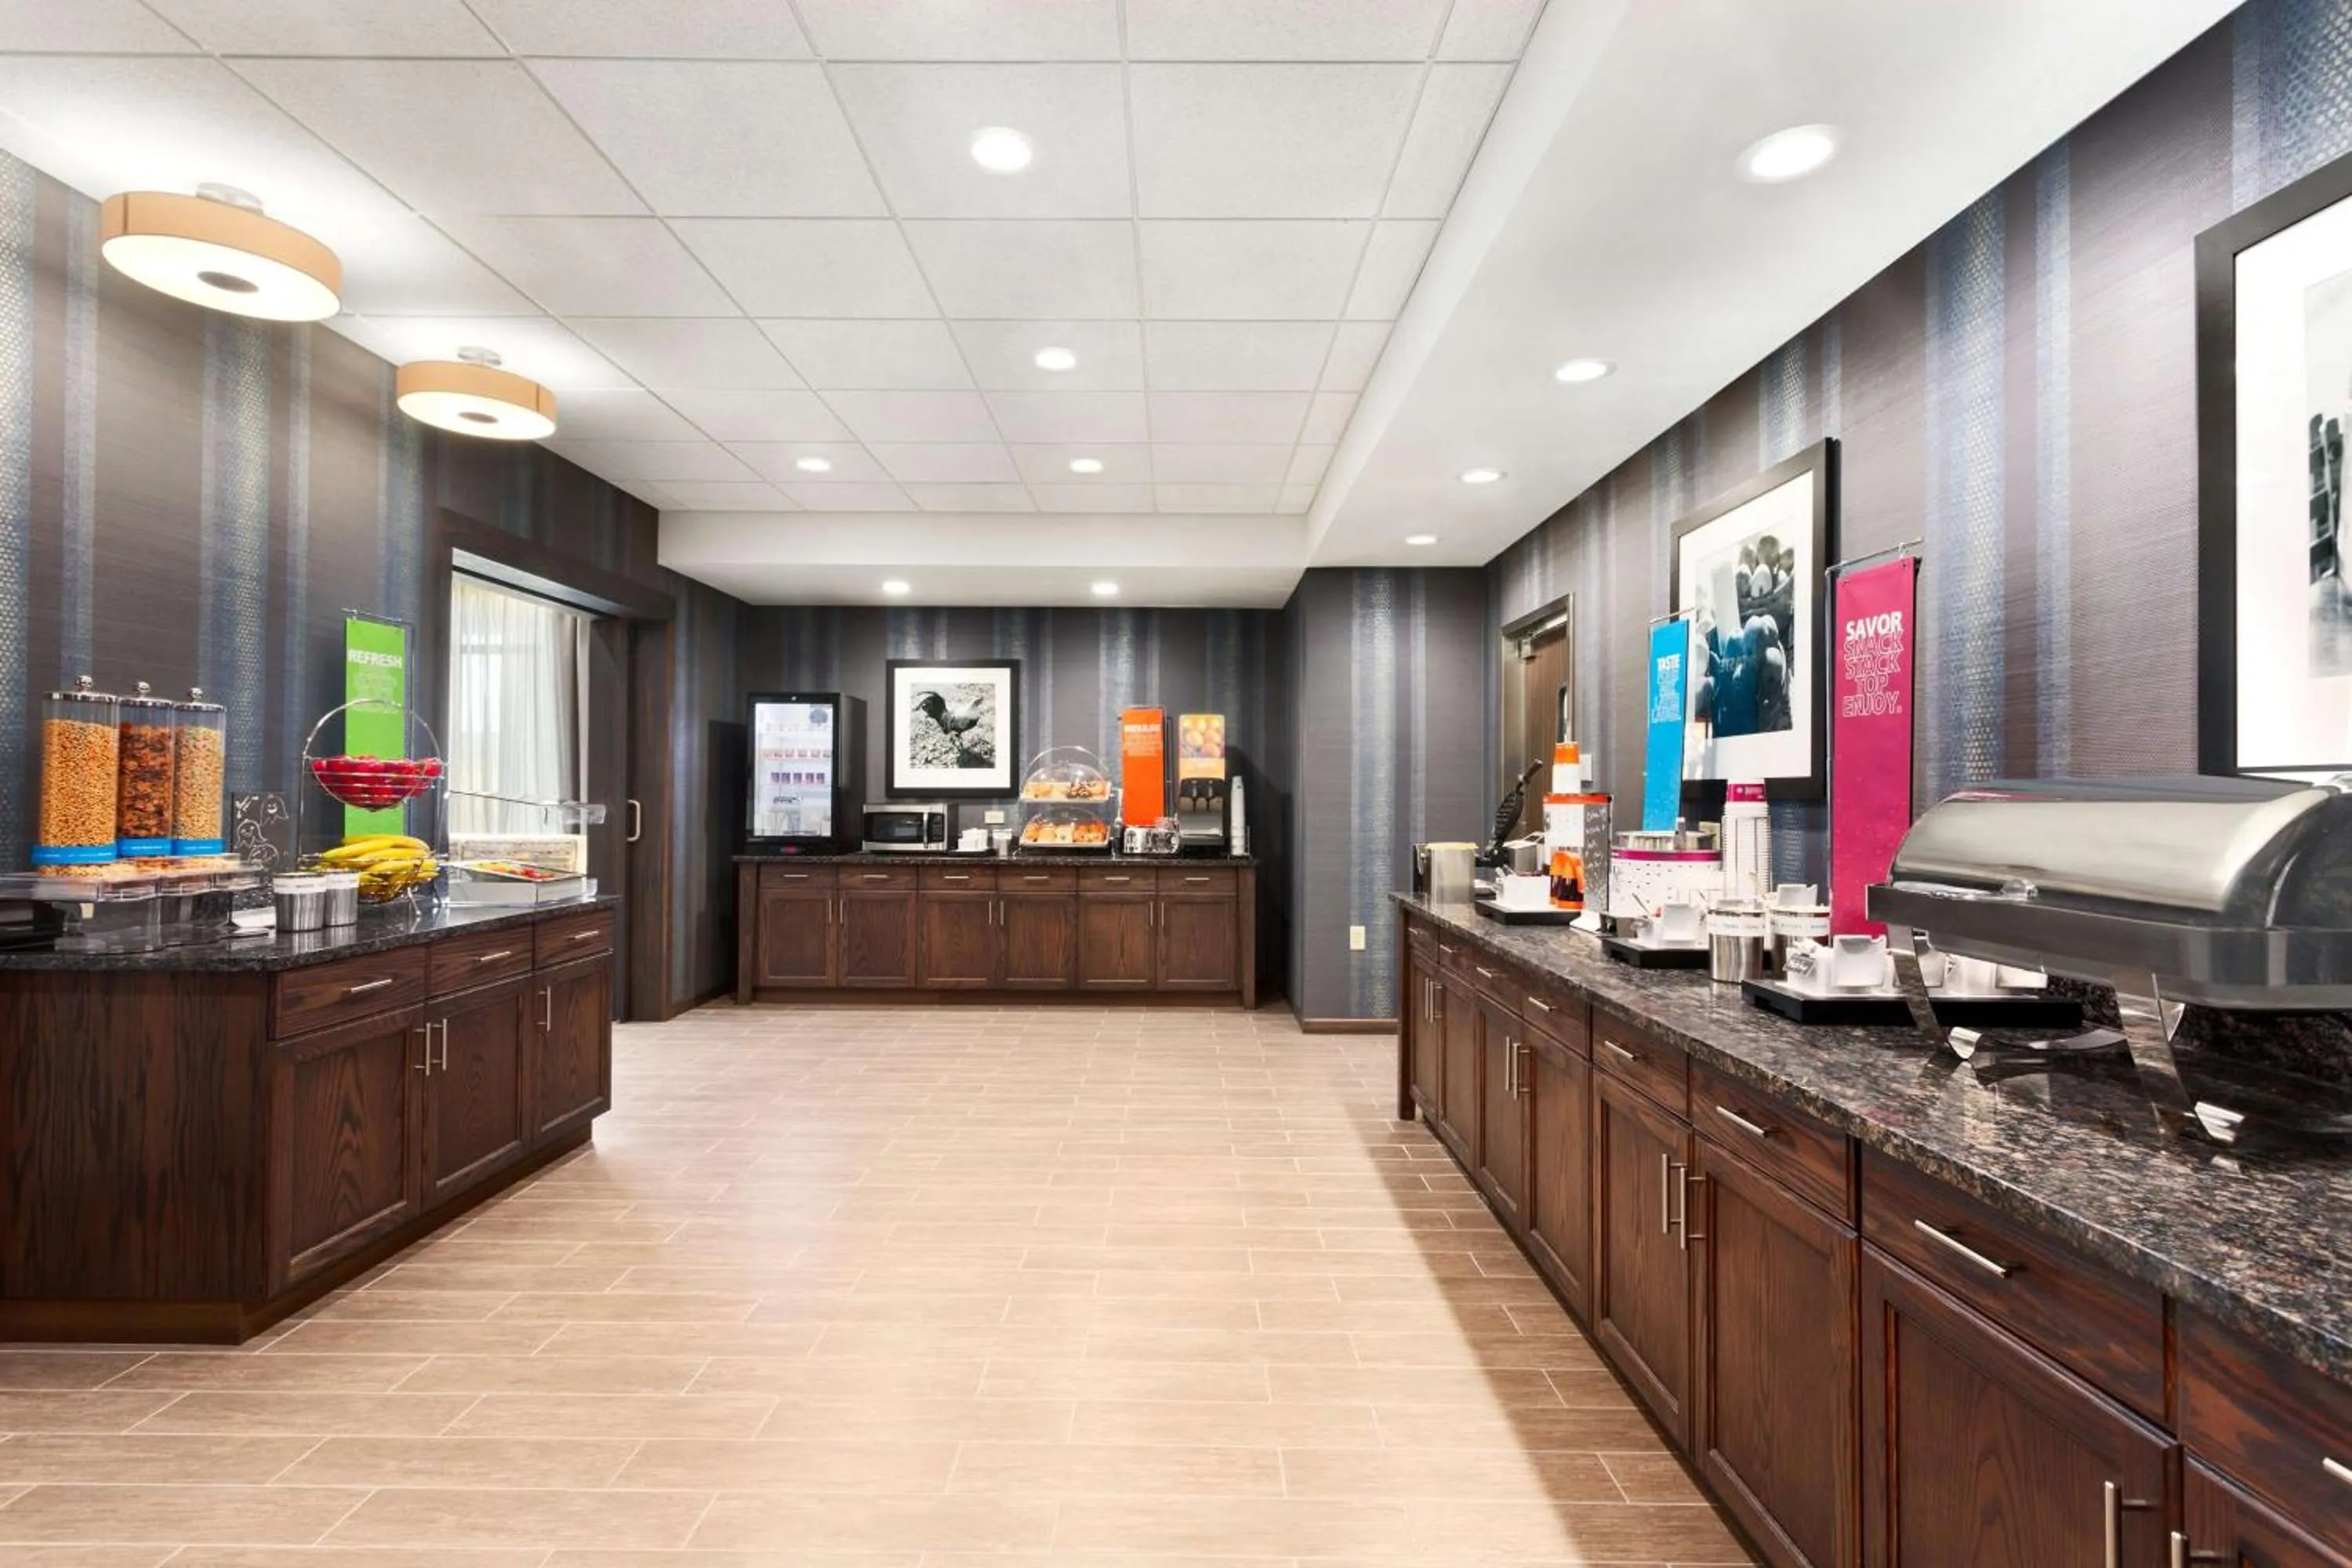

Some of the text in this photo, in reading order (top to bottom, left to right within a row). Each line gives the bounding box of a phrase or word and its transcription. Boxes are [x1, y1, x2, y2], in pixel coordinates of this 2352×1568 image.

[1846, 611, 1903, 641] SAVOR
[347, 648, 403, 669] REFRESH
[1843, 630, 1904, 662] SNACK
[1845, 652, 1901, 680] STACK
[1855, 672, 1889, 696] TOP
[1843, 691, 1903, 717] ENJOY.
